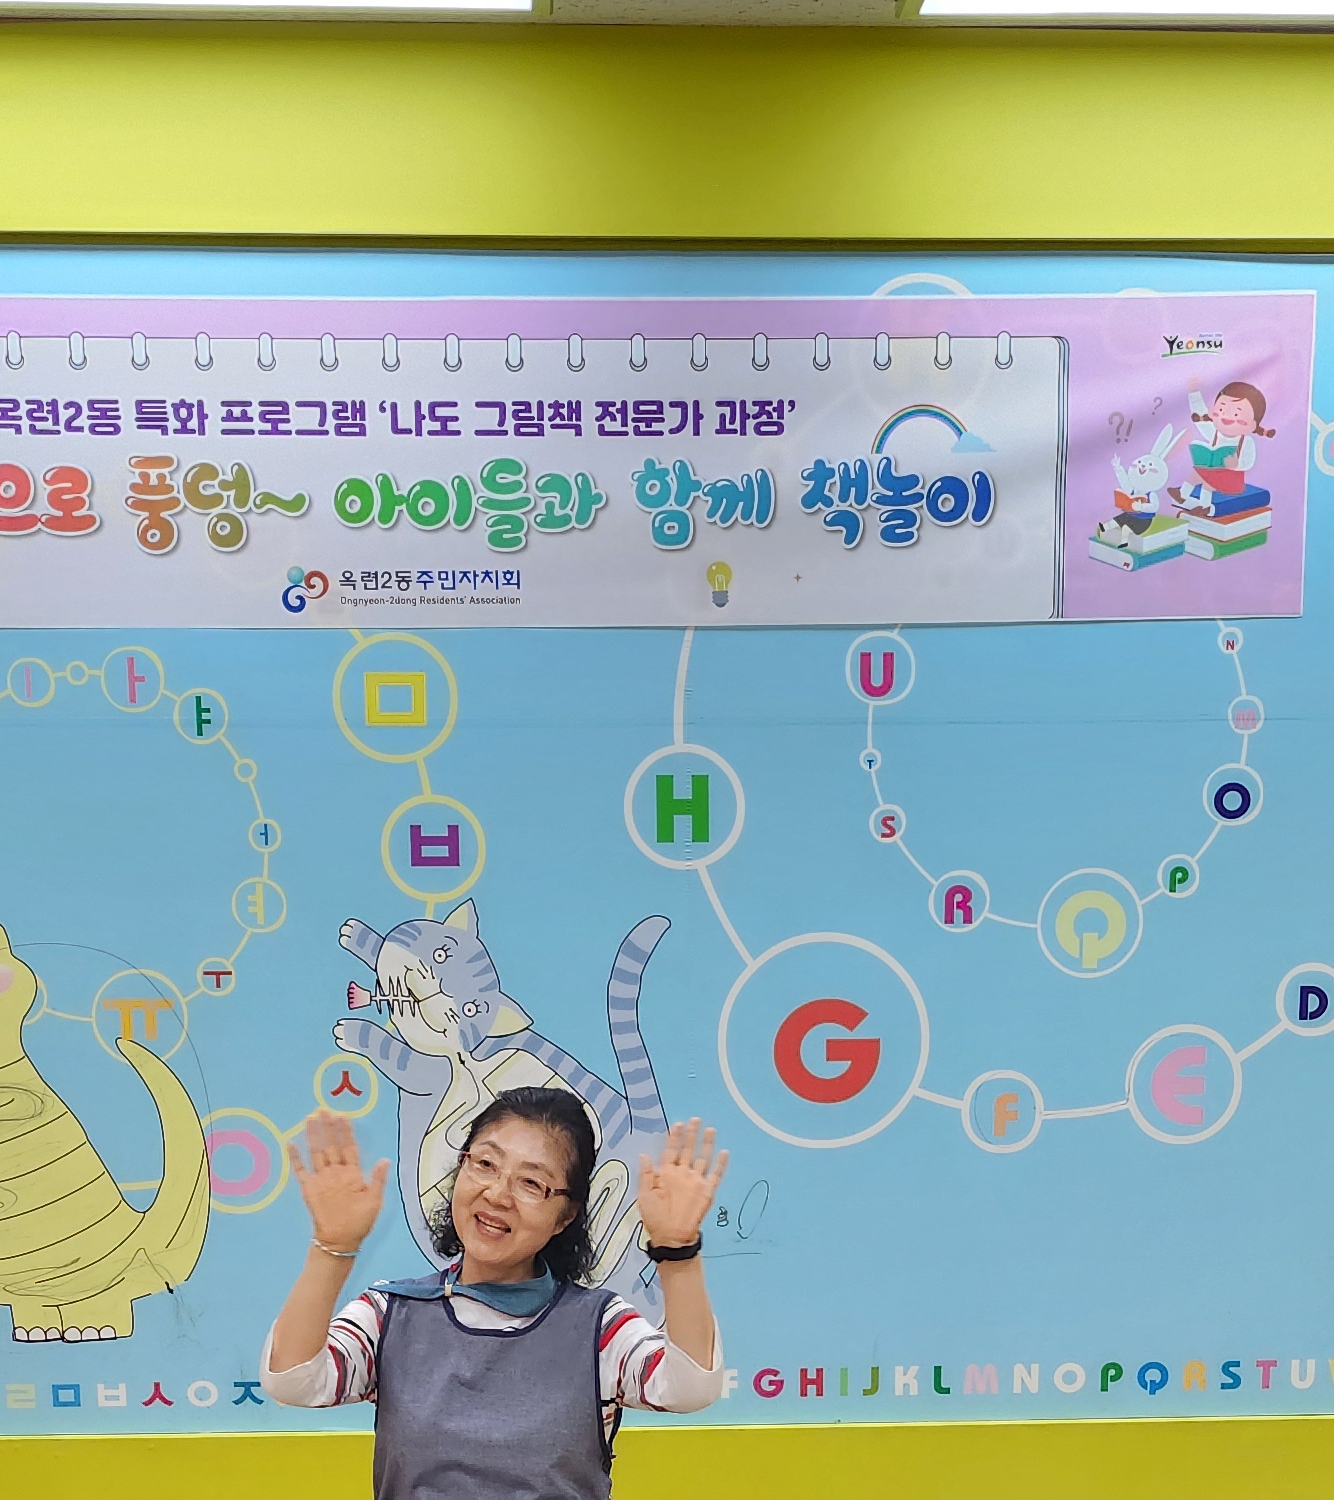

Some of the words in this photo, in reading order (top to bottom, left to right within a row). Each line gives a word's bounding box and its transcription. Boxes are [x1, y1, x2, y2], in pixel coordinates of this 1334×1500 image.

[1163, 335, 1222, 355] Yeonsu
[134, 398, 209, 437] 특화
[220, 398, 367, 437] 프로그램
[473, 399, 583, 437] 그림책
[593, 399, 704, 437] 전문가
[333, 454, 605, 554] 아이들과
[631, 454, 776, 551] 함께
[800, 452, 996, 551] 책놀이
[340, 596, 417, 606] Ongnyeon-2dong
[469, 596, 521, 605] Association
[860, 651, 894, 697] U
[655, 774, 709, 843] H
[880, 815, 896, 840] S
[1169, 865, 1189, 893] P
[944, 885, 973, 924] R
[1054, 890, 1127, 969] Q
[1298, 985, 1328, 1021] D
[773, 998, 881, 1104] G
[994, 1092, 1019, 1137] F
